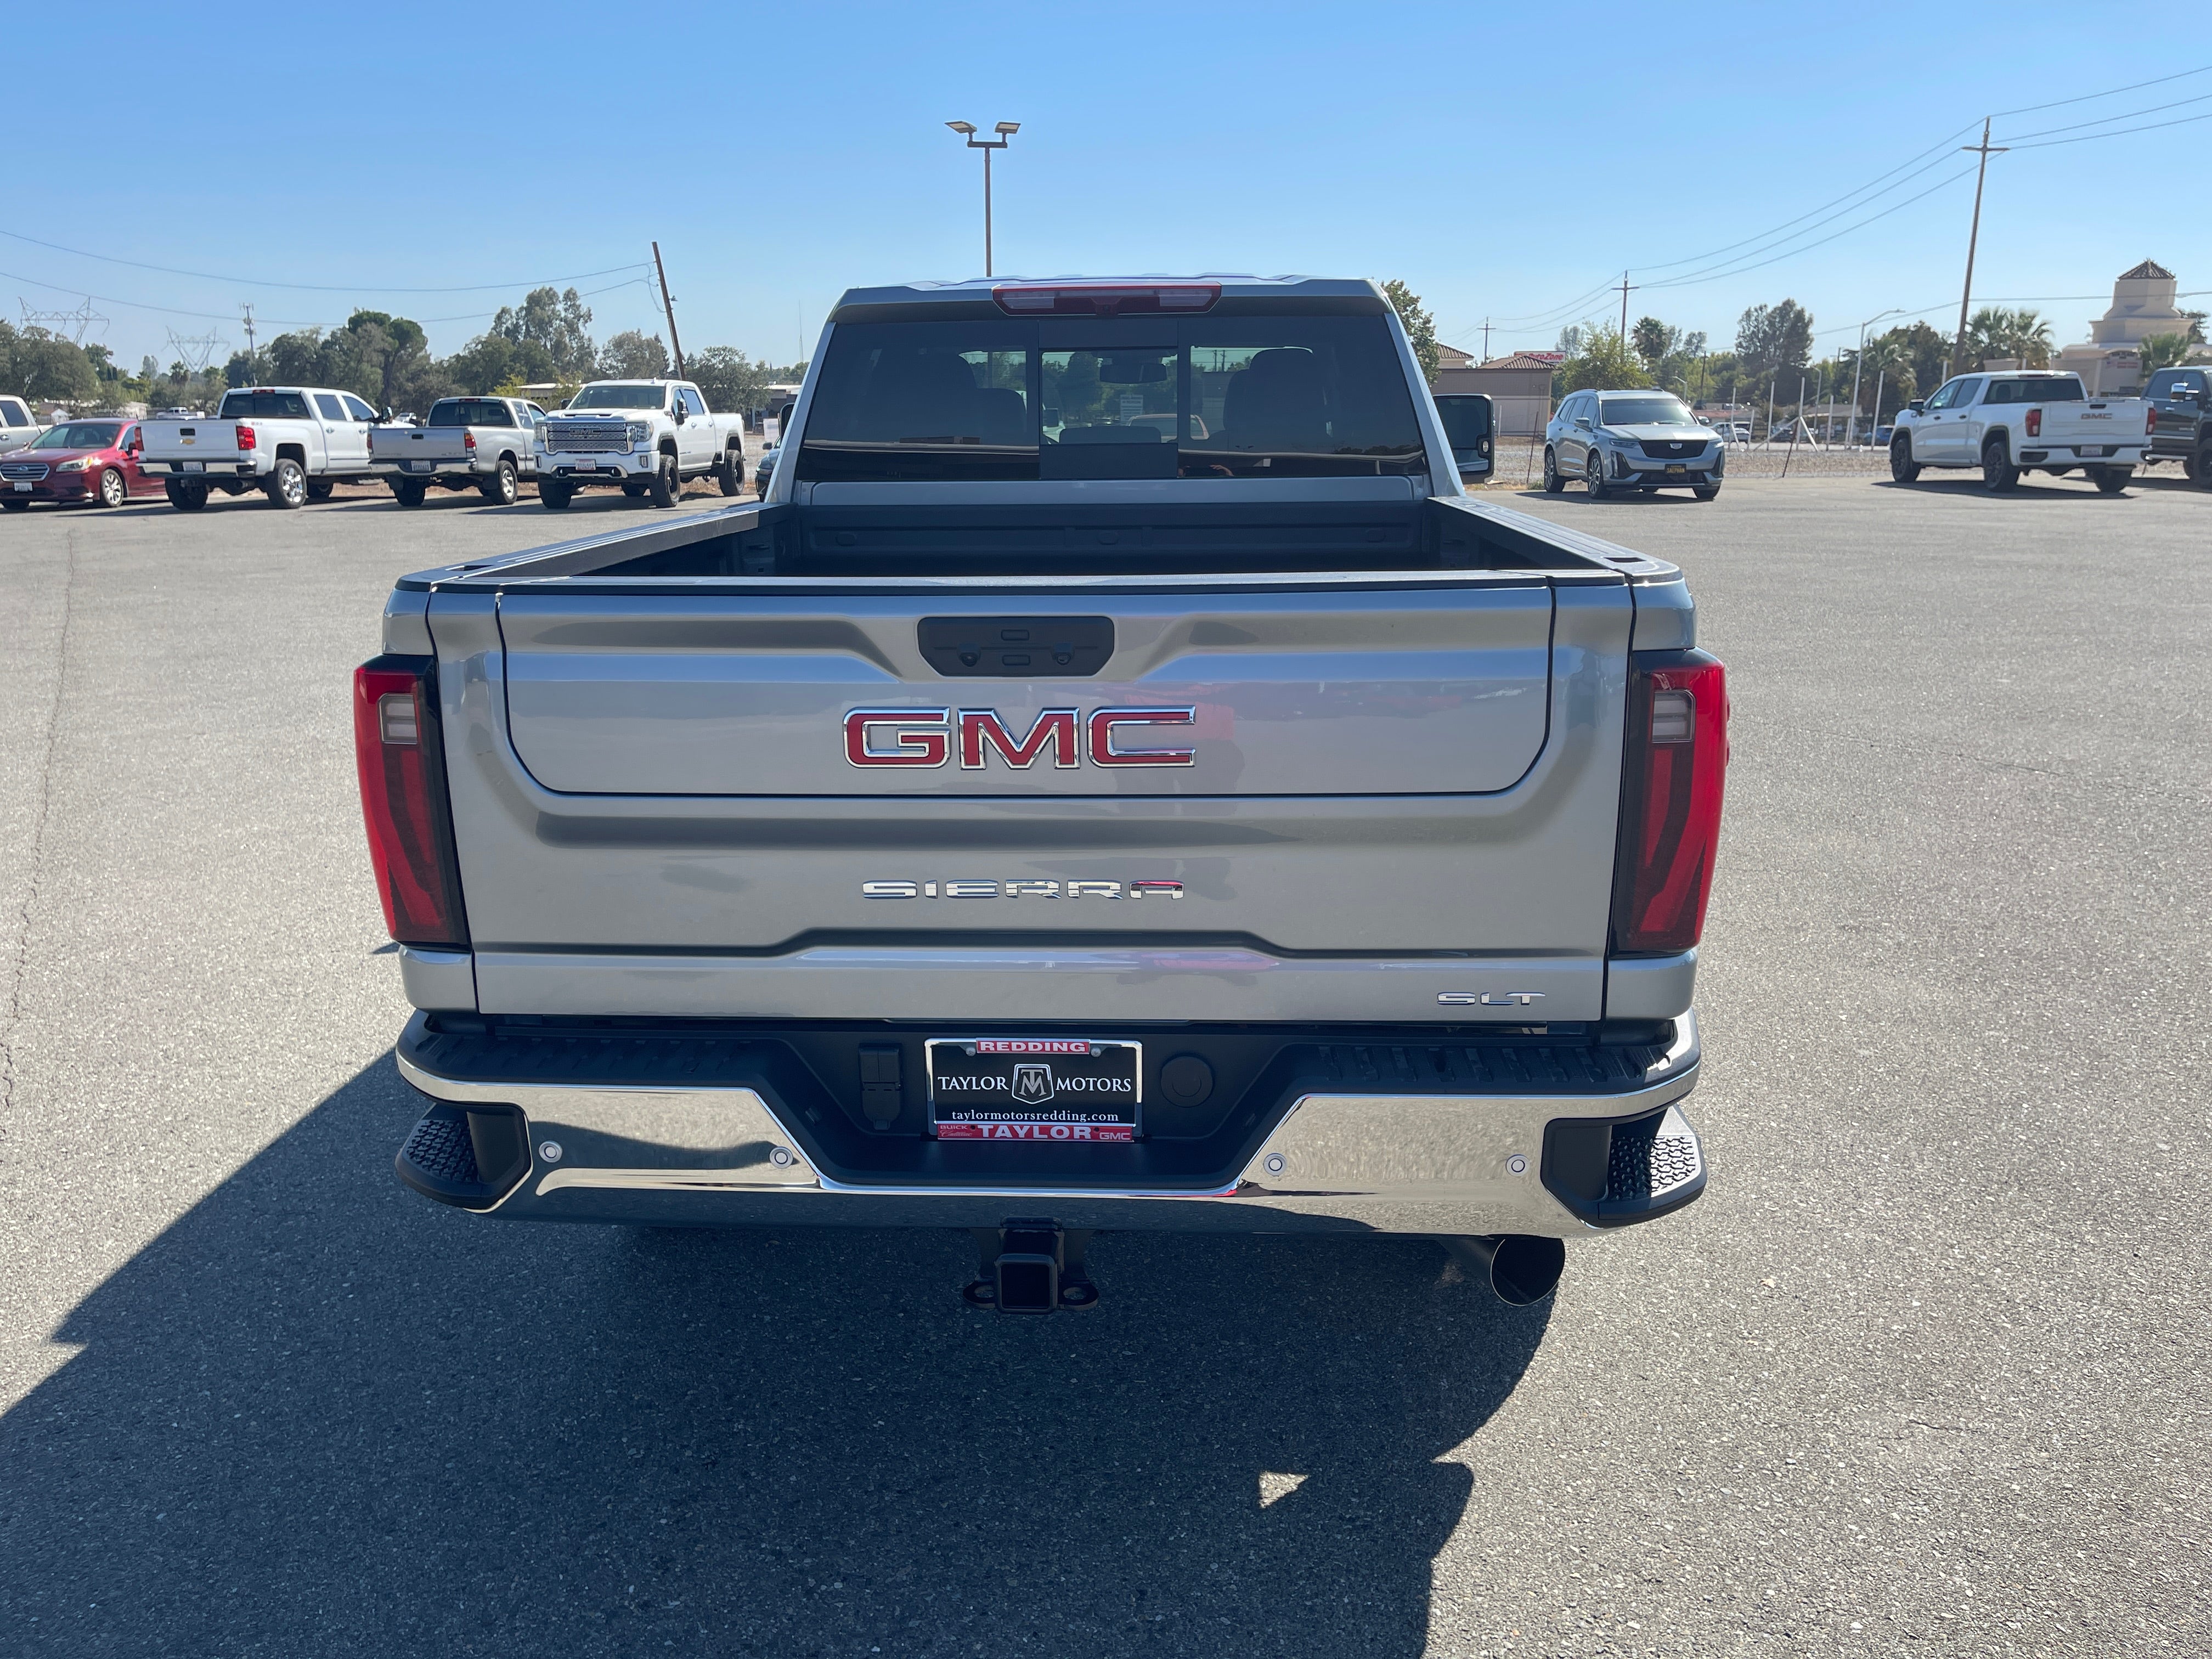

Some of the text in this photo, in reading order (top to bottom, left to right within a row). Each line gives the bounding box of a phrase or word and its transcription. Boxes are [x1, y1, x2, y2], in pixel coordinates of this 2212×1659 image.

[570, 427, 601, 436] GMC
[843, 706, 1196, 770] GMC
[862, 879, 1185, 900] SIERRA
[1437, 991, 1546, 1006] SLT
[980, 1041, 1086, 1052] REDDING
[938, 1076, 1009, 1091] TAYLOR
[1056, 1077, 1131, 1092] MOTORS
[952, 1110, 1119, 1123] taylormotorsredding.com
[977, 1124, 1092, 1139] TAYLOR
[1099, 1132, 1131, 1141] GMC
